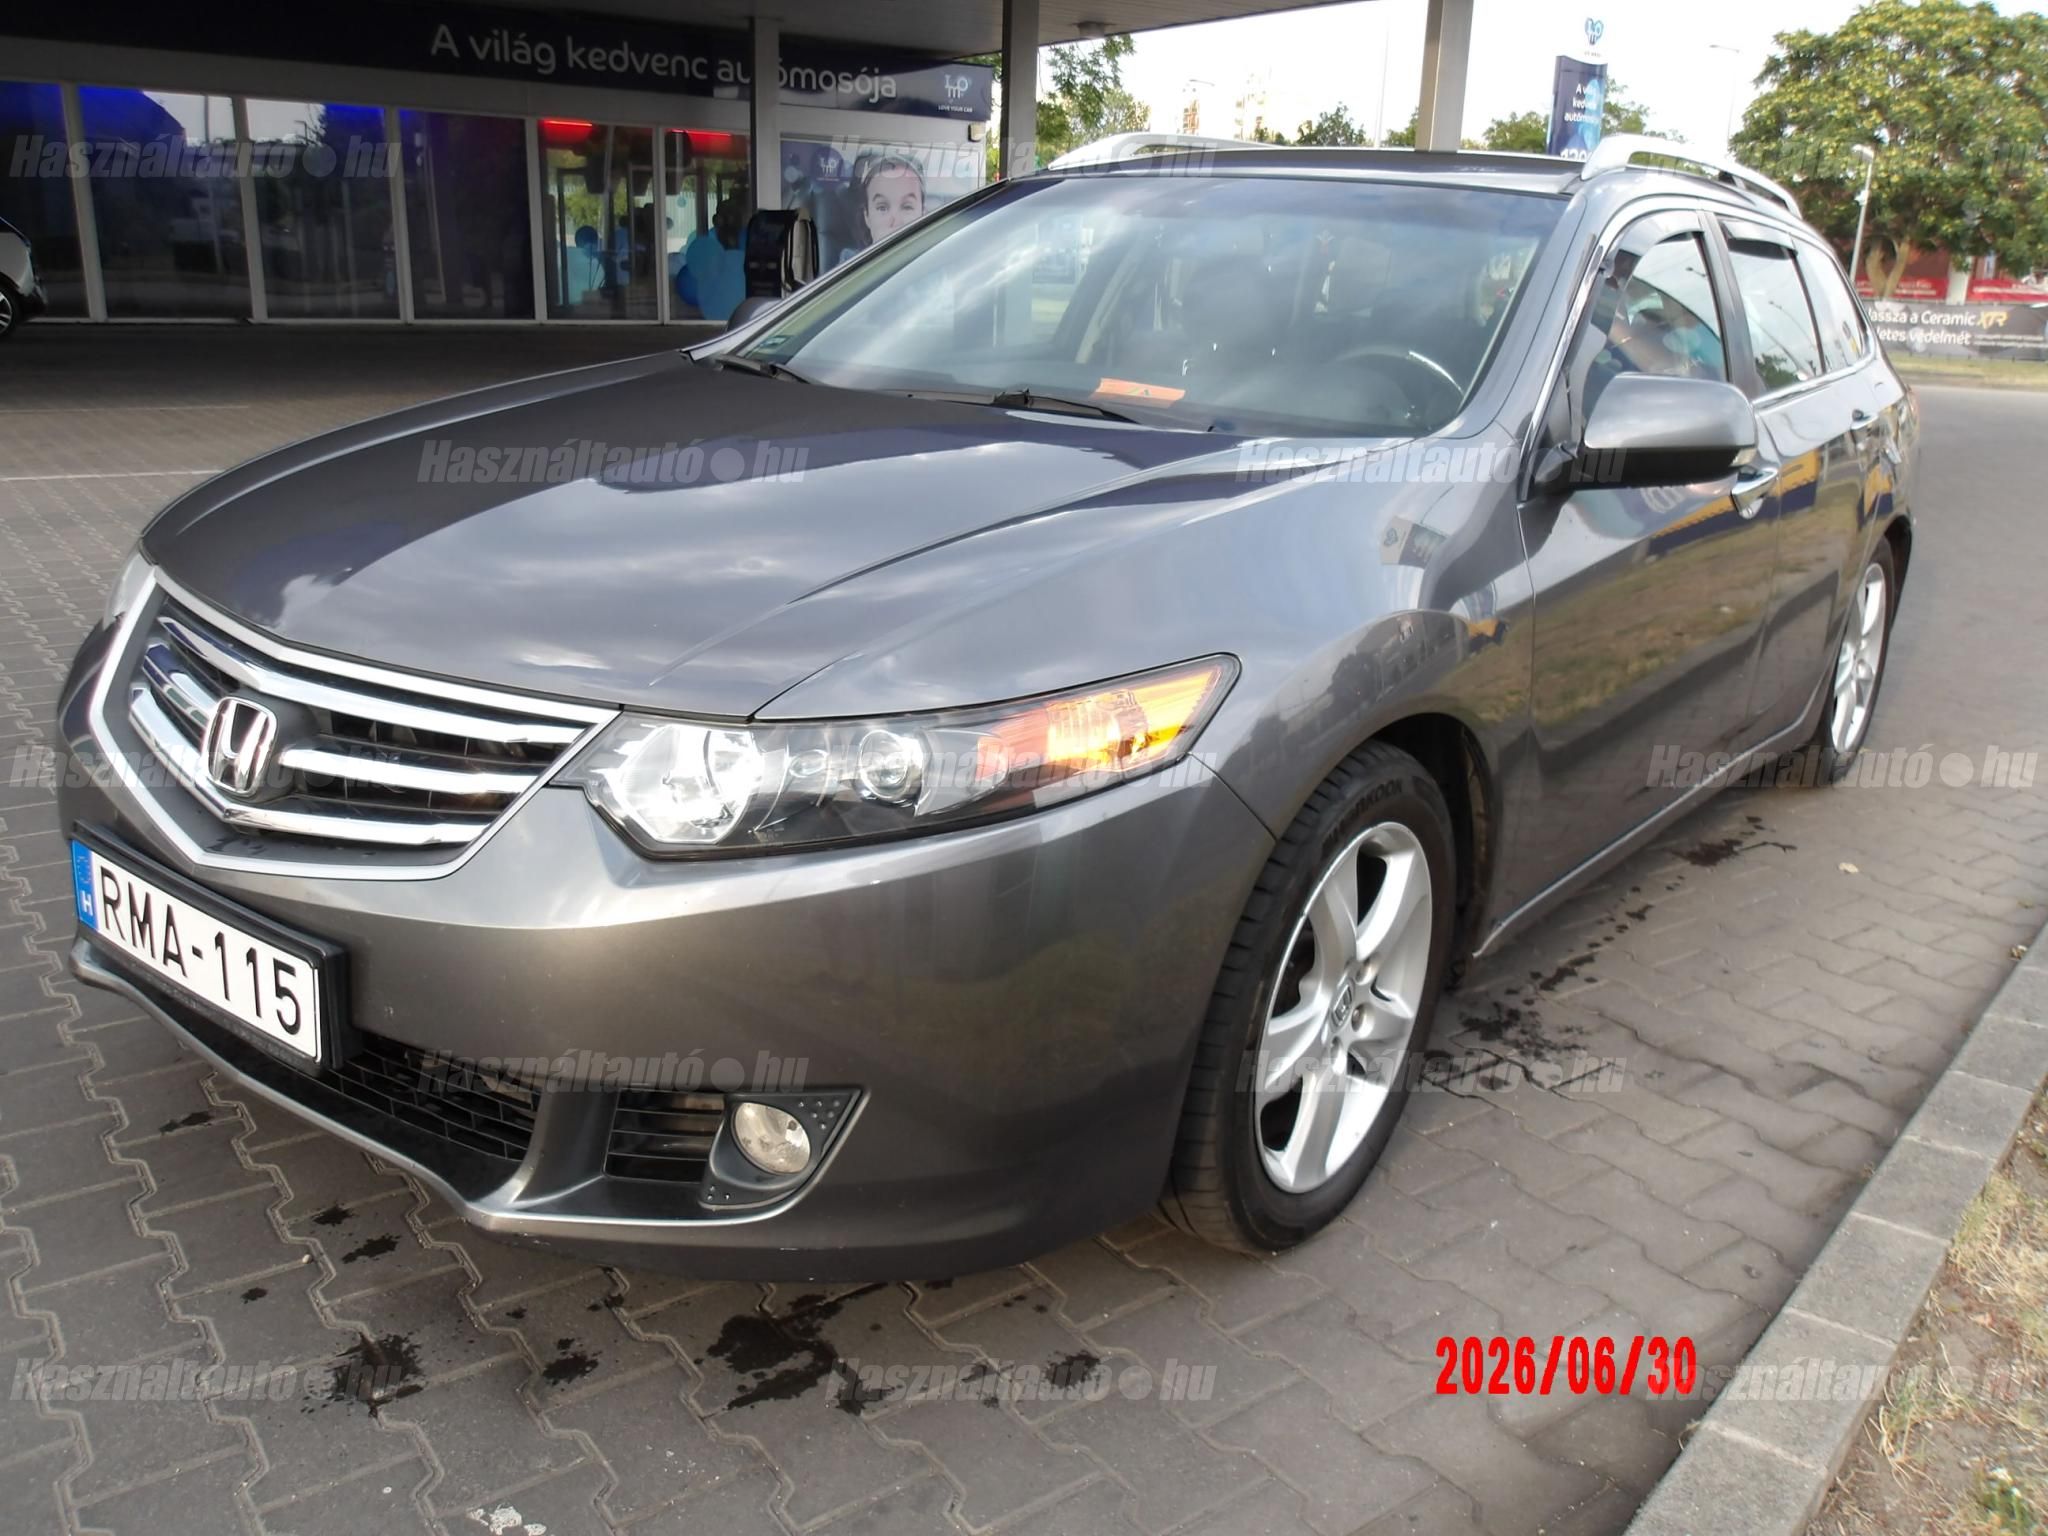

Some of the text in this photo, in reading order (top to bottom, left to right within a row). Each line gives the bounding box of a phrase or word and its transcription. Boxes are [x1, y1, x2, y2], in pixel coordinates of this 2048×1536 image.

[431, 24, 460, 58] A
[469, 28, 557, 75] világ
[566, 35, 708, 80] kedvenc
[1921, 310, 1976, 326] Ceramic
[1909, 328, 1972, 345] védelmét
[81, 890, 94, 917] H
[99, 865, 301, 1036] RMA-115
